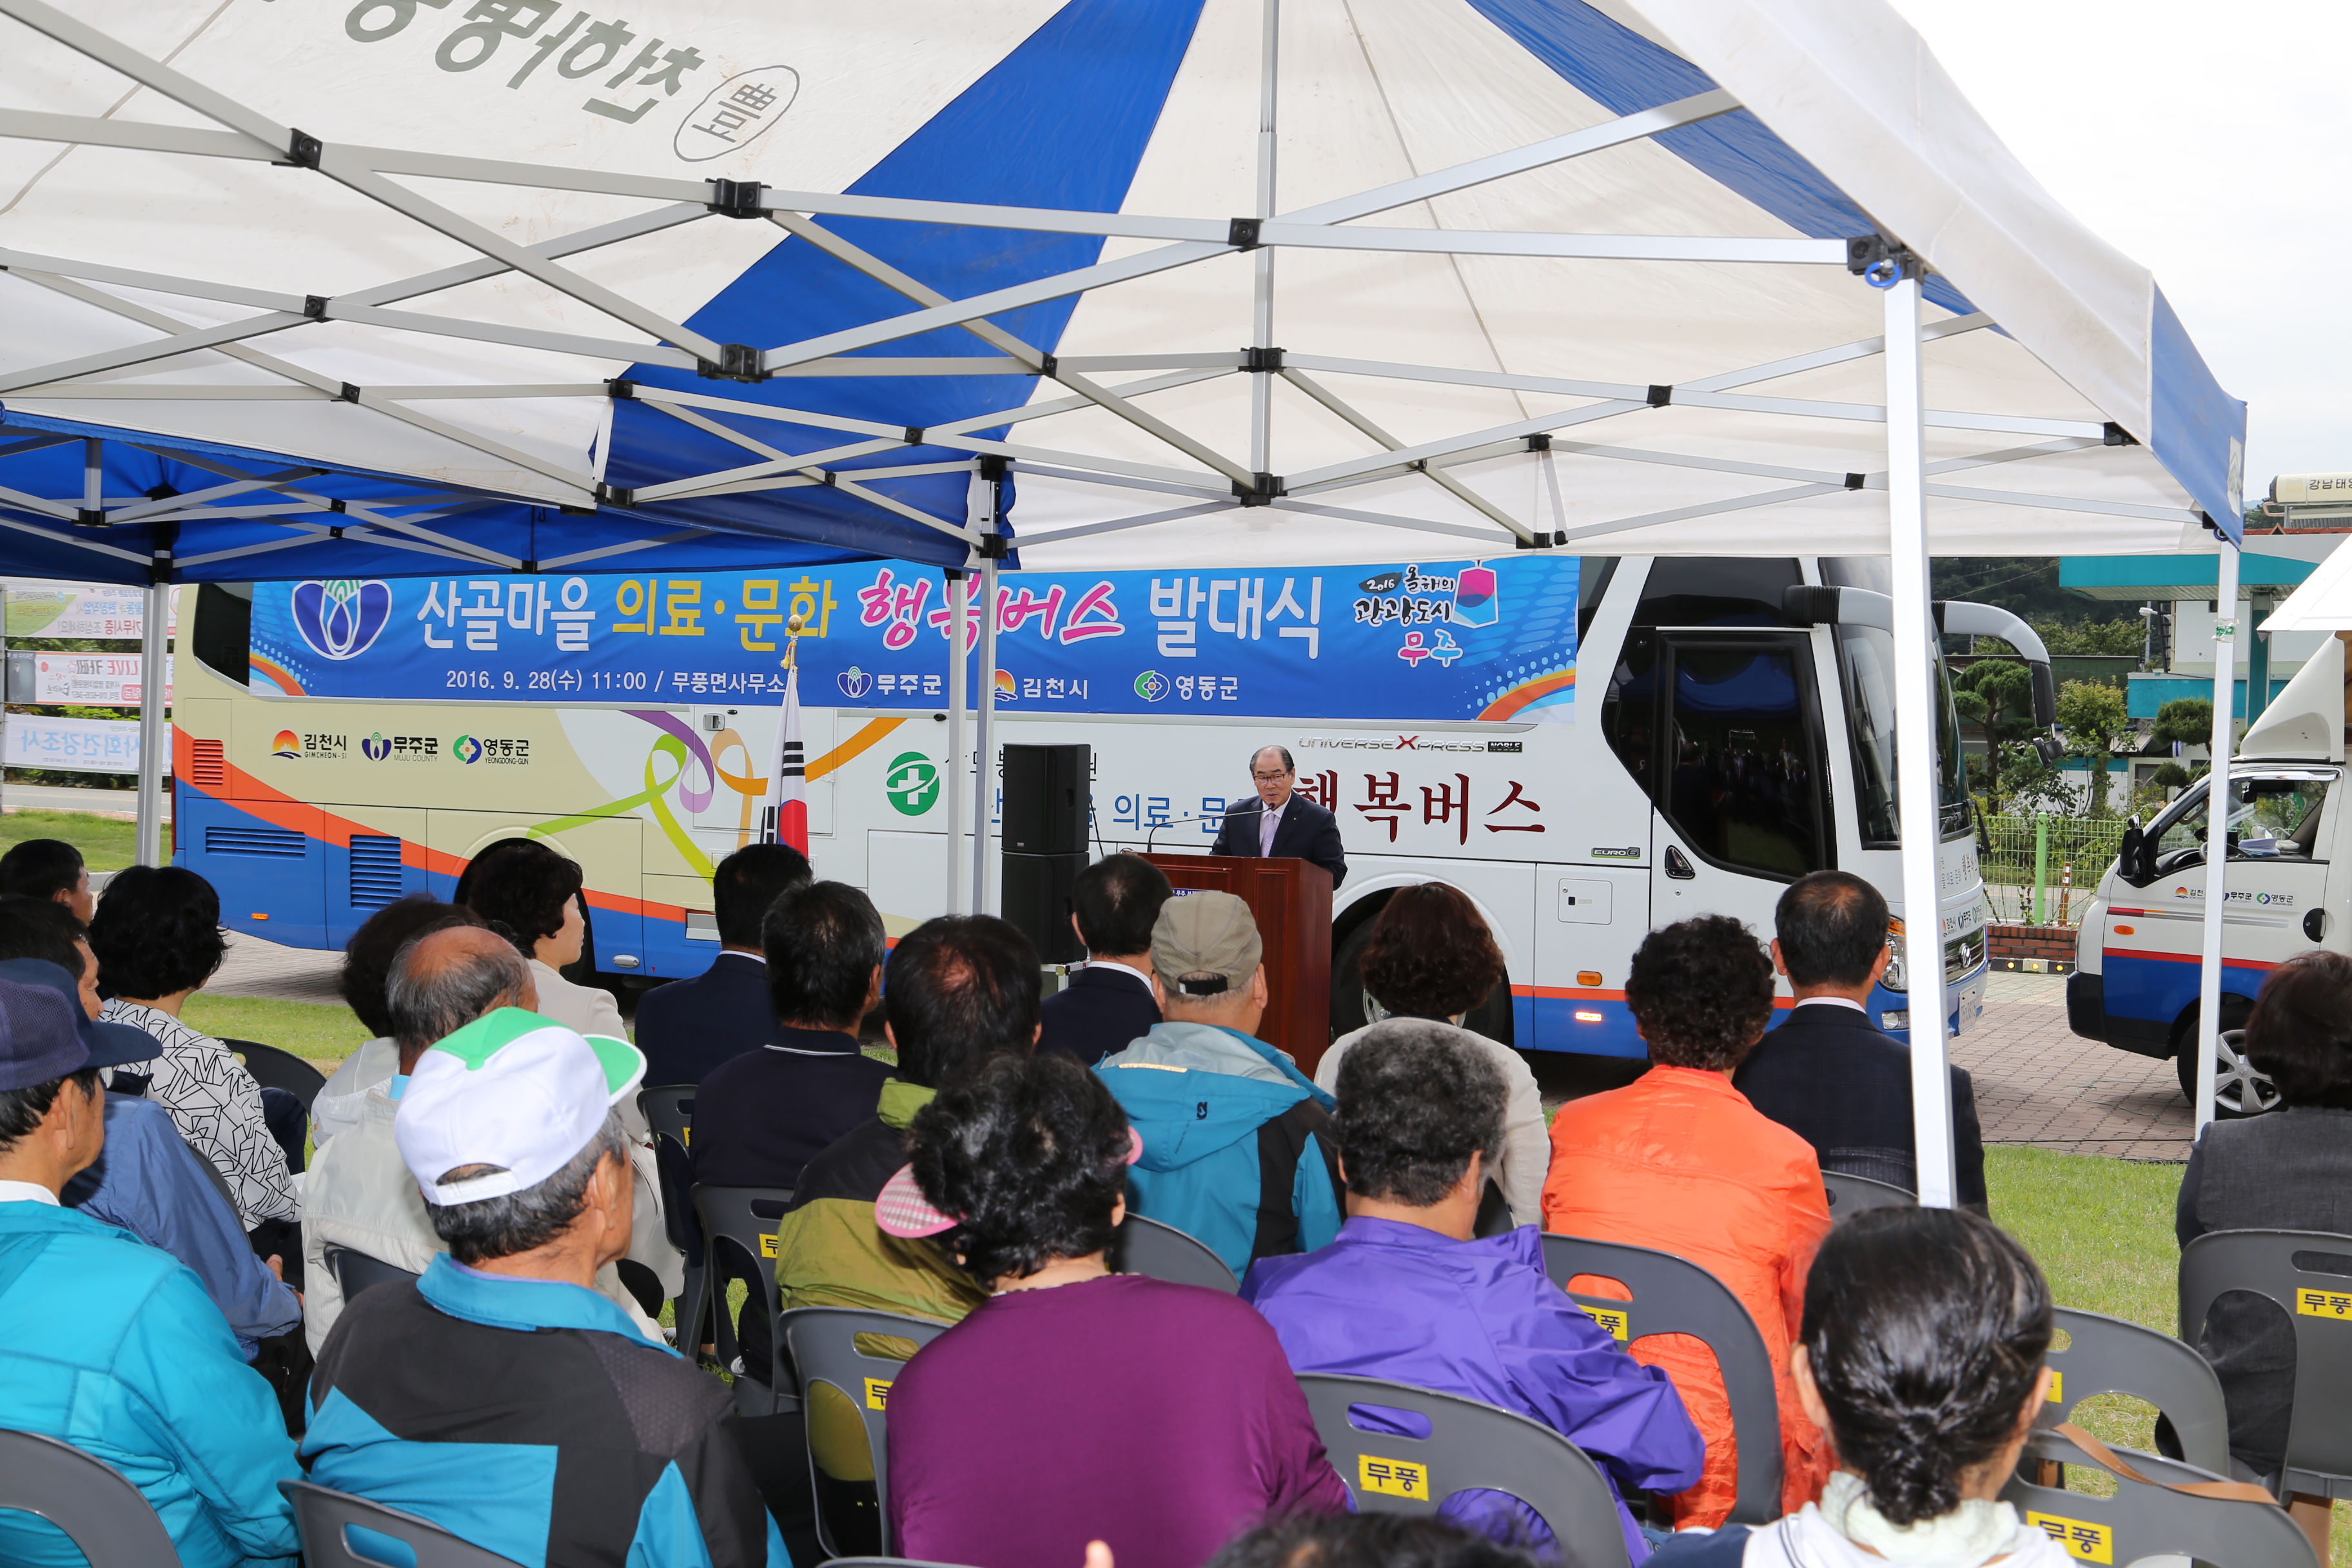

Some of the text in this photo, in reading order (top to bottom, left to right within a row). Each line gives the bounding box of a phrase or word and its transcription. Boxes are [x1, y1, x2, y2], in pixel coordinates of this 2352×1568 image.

[1366, 565, 1456, 594] 2016 올해의
[416, 576, 596, 652] 산골마을
[612, 575, 838, 652] 의료·문화
[1150, 576, 1323, 660] 발대식
[1353, 596, 1452, 627] 관광도시
[1398, 627, 1464, 668] 무주
[446, 671, 495, 690] 2016.
[502, 671, 520, 690] 9.
[528, 669, 583, 691] 28(수)
[592, 671, 647, 690] 11:00
[672, 671, 785, 694] 무풍면사무소
[877, 674, 942, 696] 무주군
[1023, 677, 1089, 700] 김천시
[1175, 675, 1239, 701] 영동군
[304, 732, 348, 752] 김천시
[393, 736, 438, 756] 무주군
[484, 738, 529, 758] 영동군
[304, 751, 348, 760] GIMCHEON-SI
[1113, 794, 1226, 834] 의료·문
[2230, 892, 2252, 900] 무주군
[2271, 894, 2293, 903] 영동군
[2304, 1293, 2351, 1314] 무풍
[1367, 1462, 1420, 1491] 무풍
[2039, 1520, 2102, 1554] 무풍
